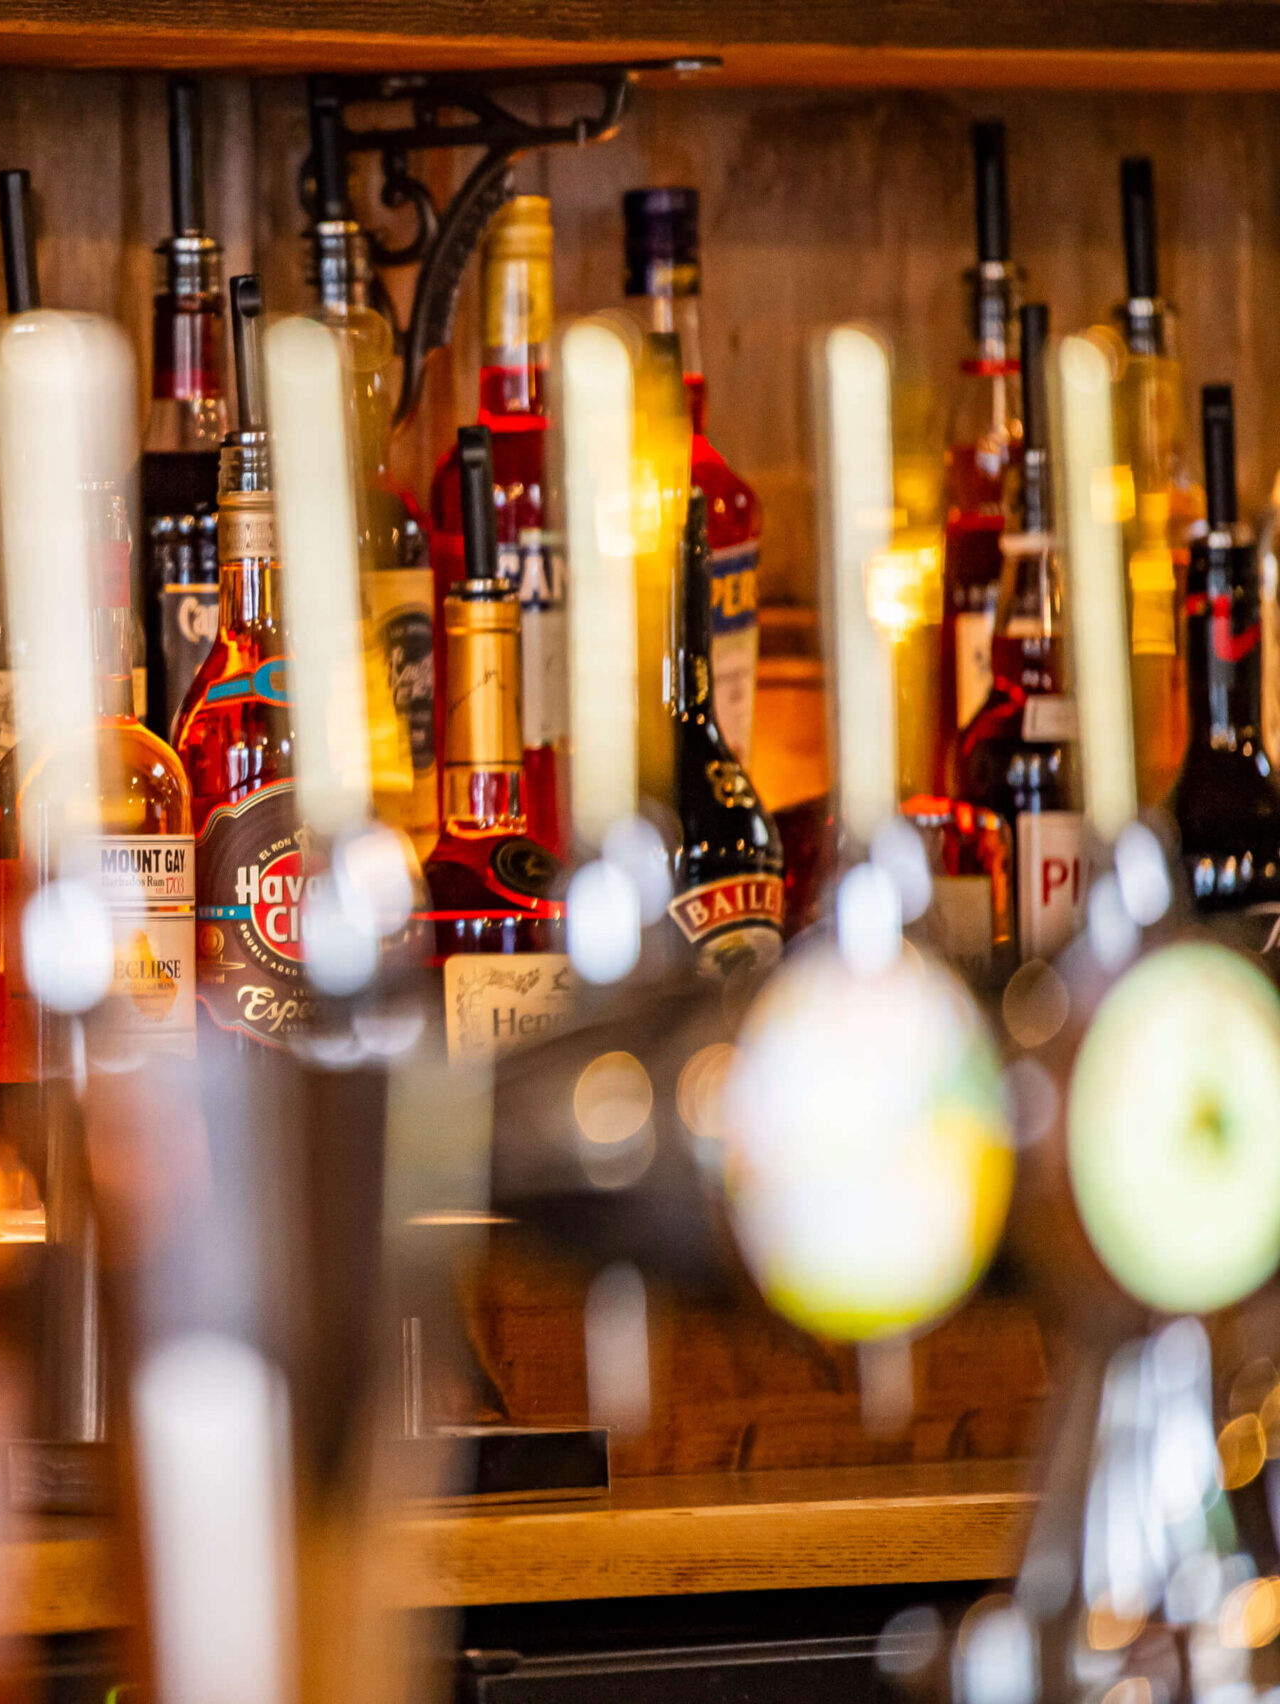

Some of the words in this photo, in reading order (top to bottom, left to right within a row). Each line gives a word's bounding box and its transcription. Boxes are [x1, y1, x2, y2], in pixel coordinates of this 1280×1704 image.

[100, 848, 162, 874] MOUNT
[164, 848, 186, 874] GAY
[146, 875, 165, 888] Rum
